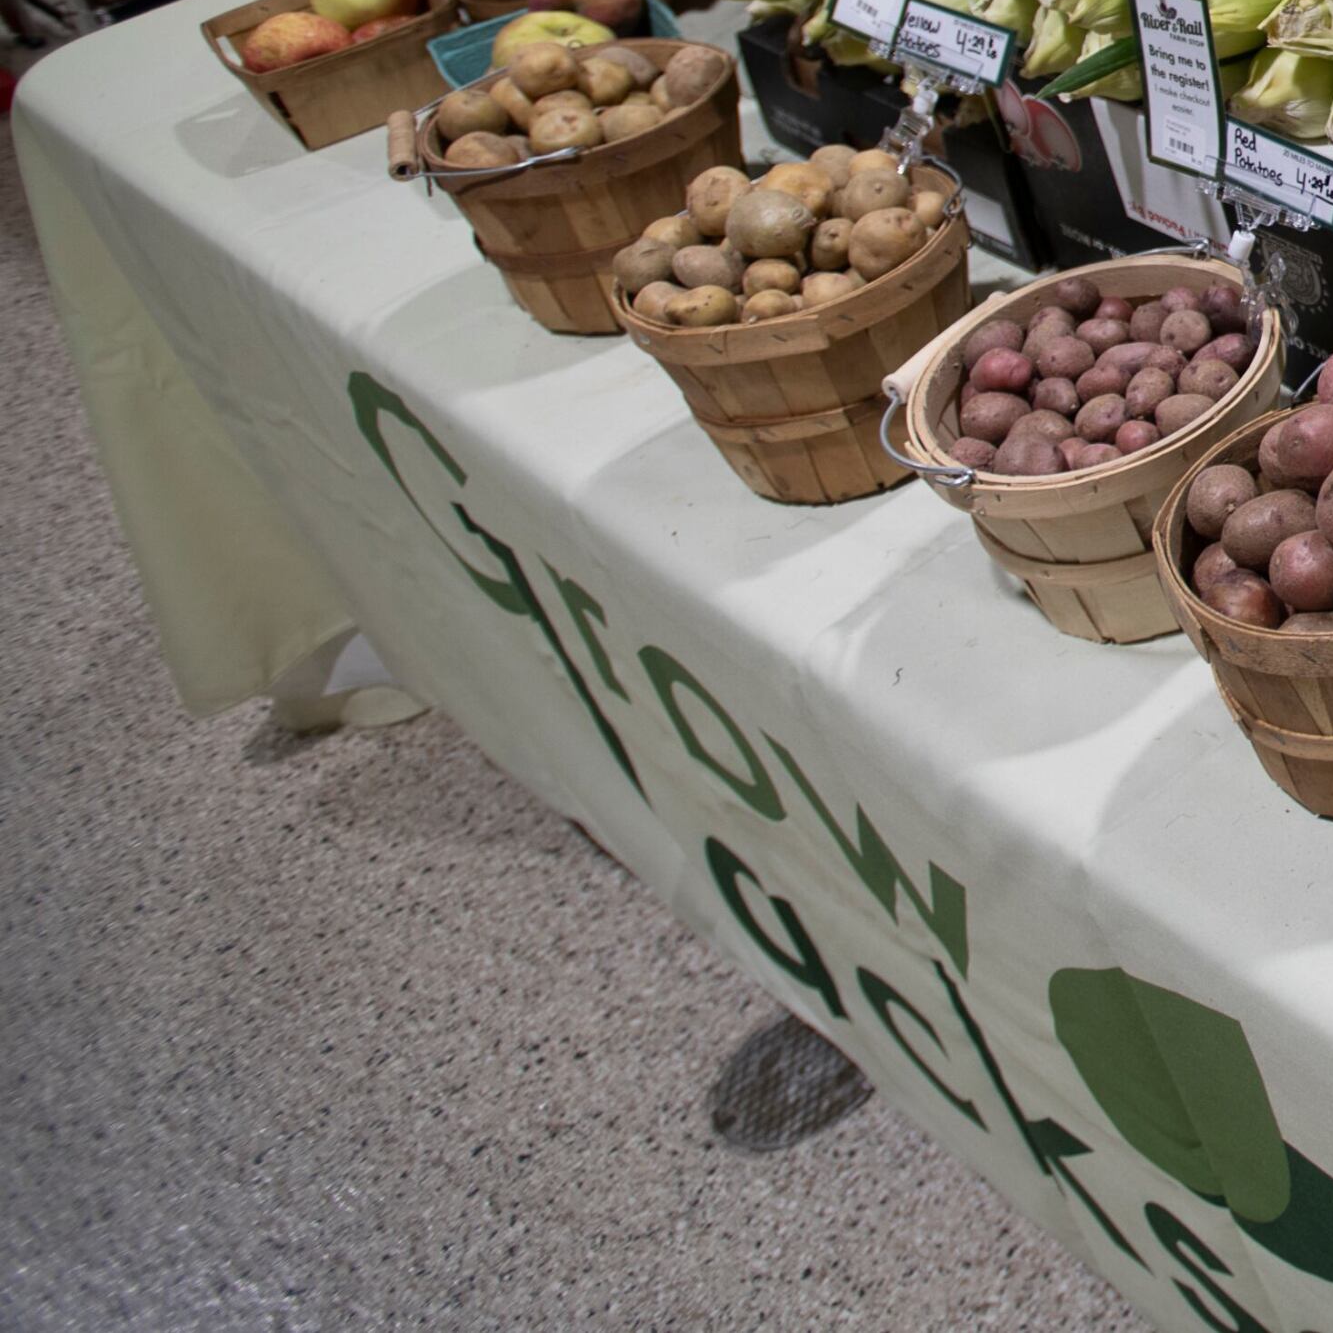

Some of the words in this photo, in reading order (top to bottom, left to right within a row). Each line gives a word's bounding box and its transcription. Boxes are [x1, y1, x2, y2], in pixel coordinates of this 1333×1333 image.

[1140, 12, 1171, 32] River
[1176, 17, 1204, 37] Rail
[897, 30, 941, 59] tatoes
[1148, 44, 1175, 66] Bring
[1178, 56, 1194, 68] me
[1195, 58, 1207, 71] to
[1150, 63, 1166, 79] the
[1168, 72, 1210, 92] register!
[1159, 85, 1178, 98] make
[1179, 91, 1211, 107] checkout
[1235, 127, 1257, 153] Red
[1235, 147, 1283, 187] Potatoes
[1296, 167, 1323, 194] 4.29
[450, 501, 1322, 1333] Jacks
